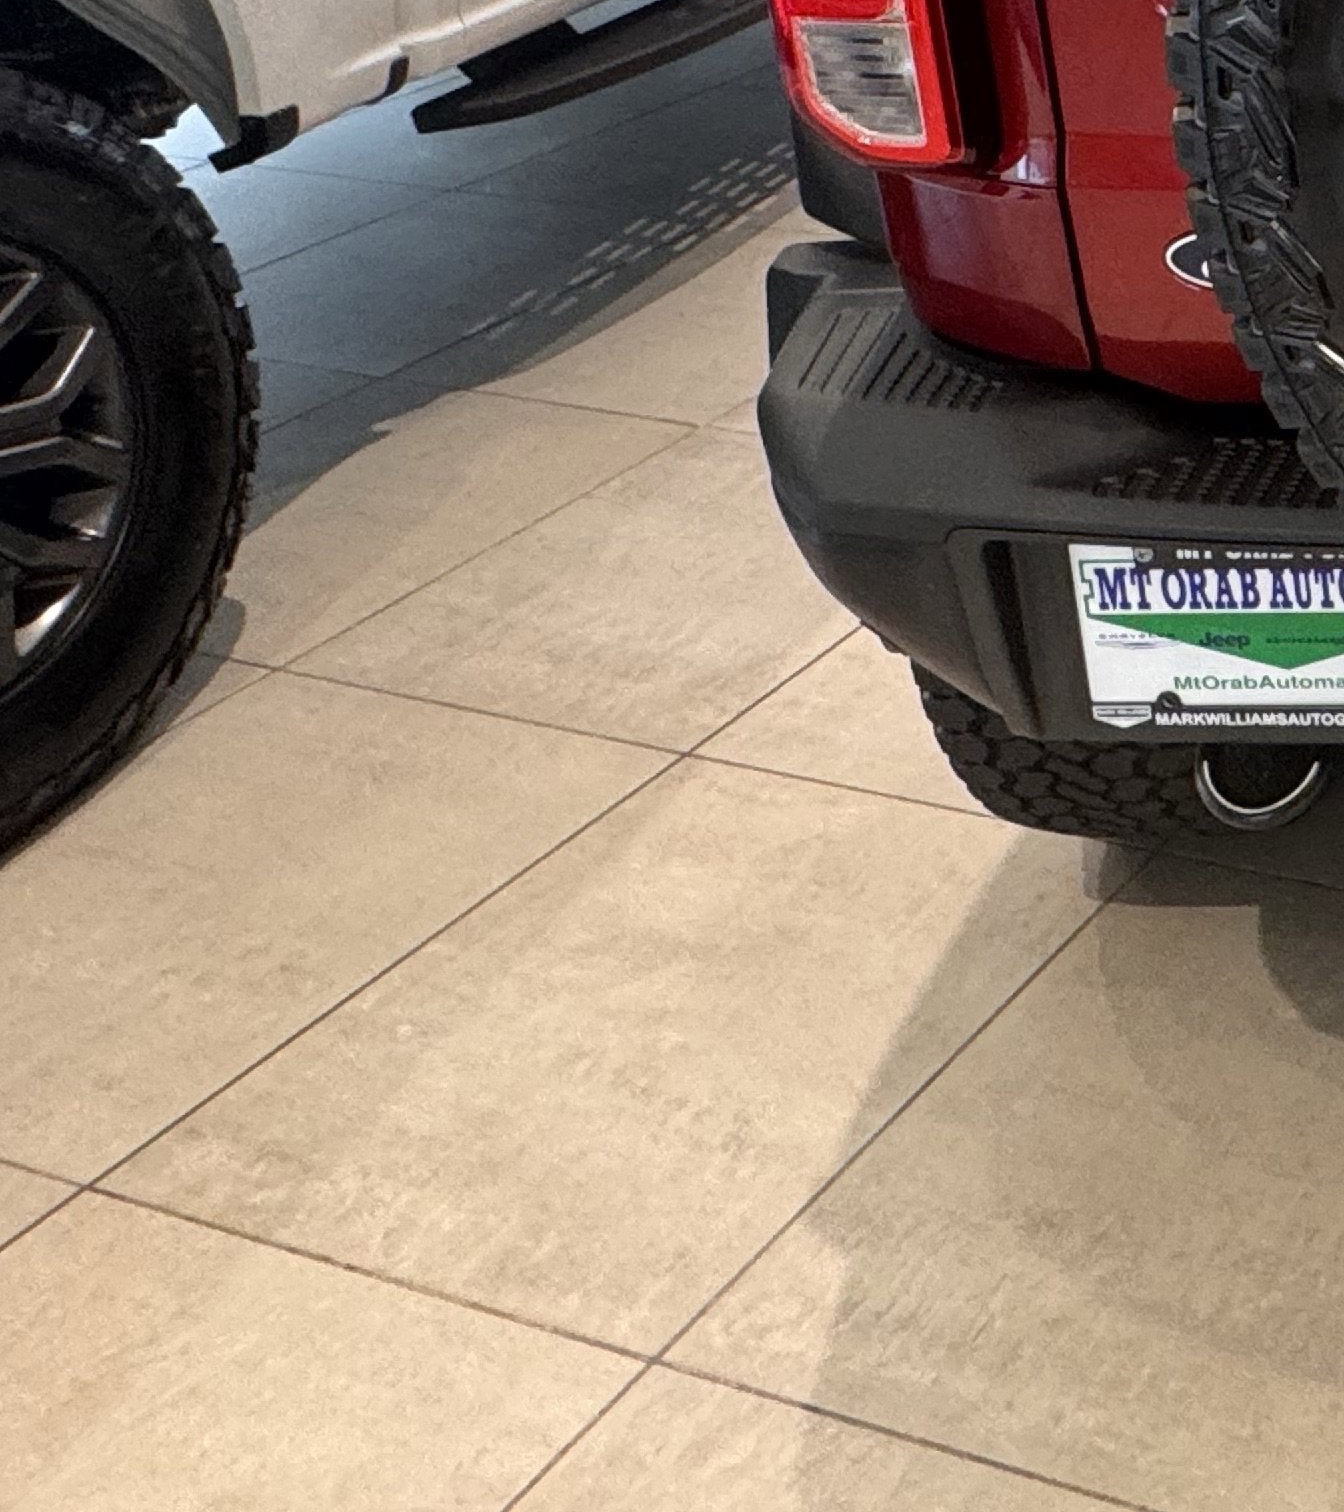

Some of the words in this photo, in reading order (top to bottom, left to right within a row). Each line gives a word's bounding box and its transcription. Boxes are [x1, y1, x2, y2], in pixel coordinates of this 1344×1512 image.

[1094, 567, 1152, 610] MT
[1161, 568, 1261, 610] ORAB
[1198, 631, 1252, 649] Jeep
